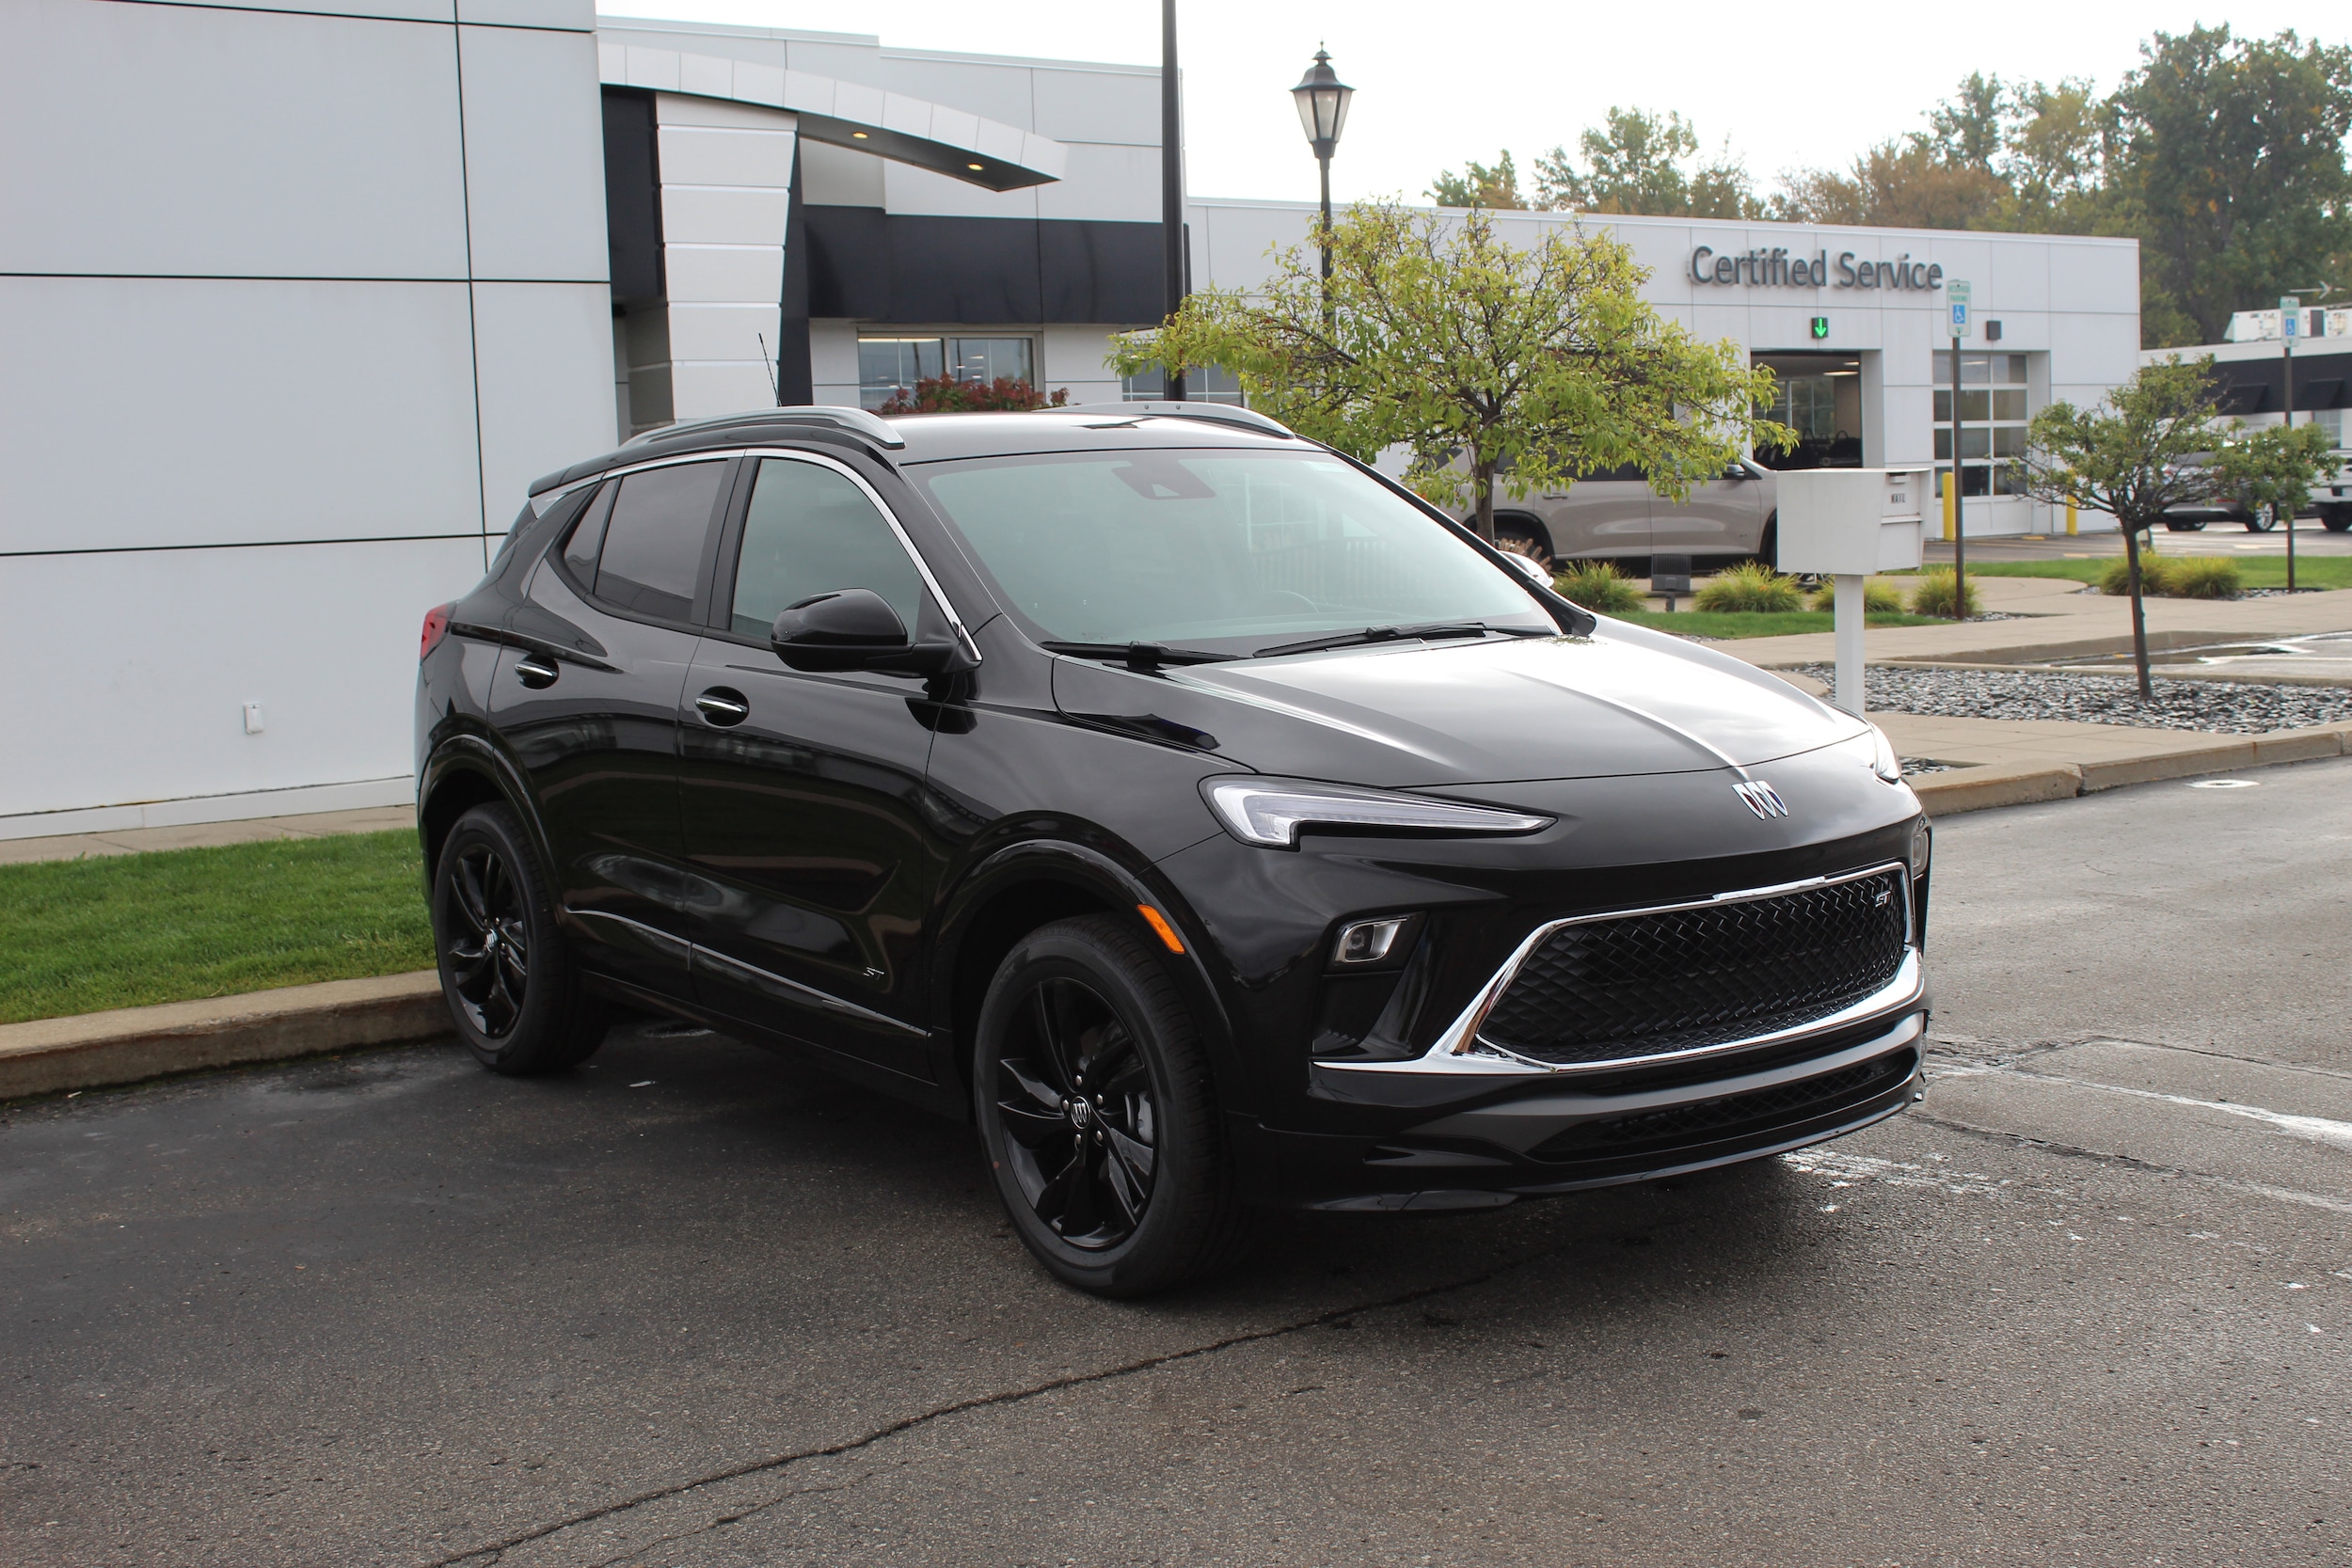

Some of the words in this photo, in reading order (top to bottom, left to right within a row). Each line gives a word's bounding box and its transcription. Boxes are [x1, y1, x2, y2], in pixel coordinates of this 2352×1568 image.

[1690, 245, 1827, 287] Certified
[1838, 251, 1944, 290] Service
[1891, 493, 1906, 503] MAIL
[1875, 889, 1892, 908] ST
